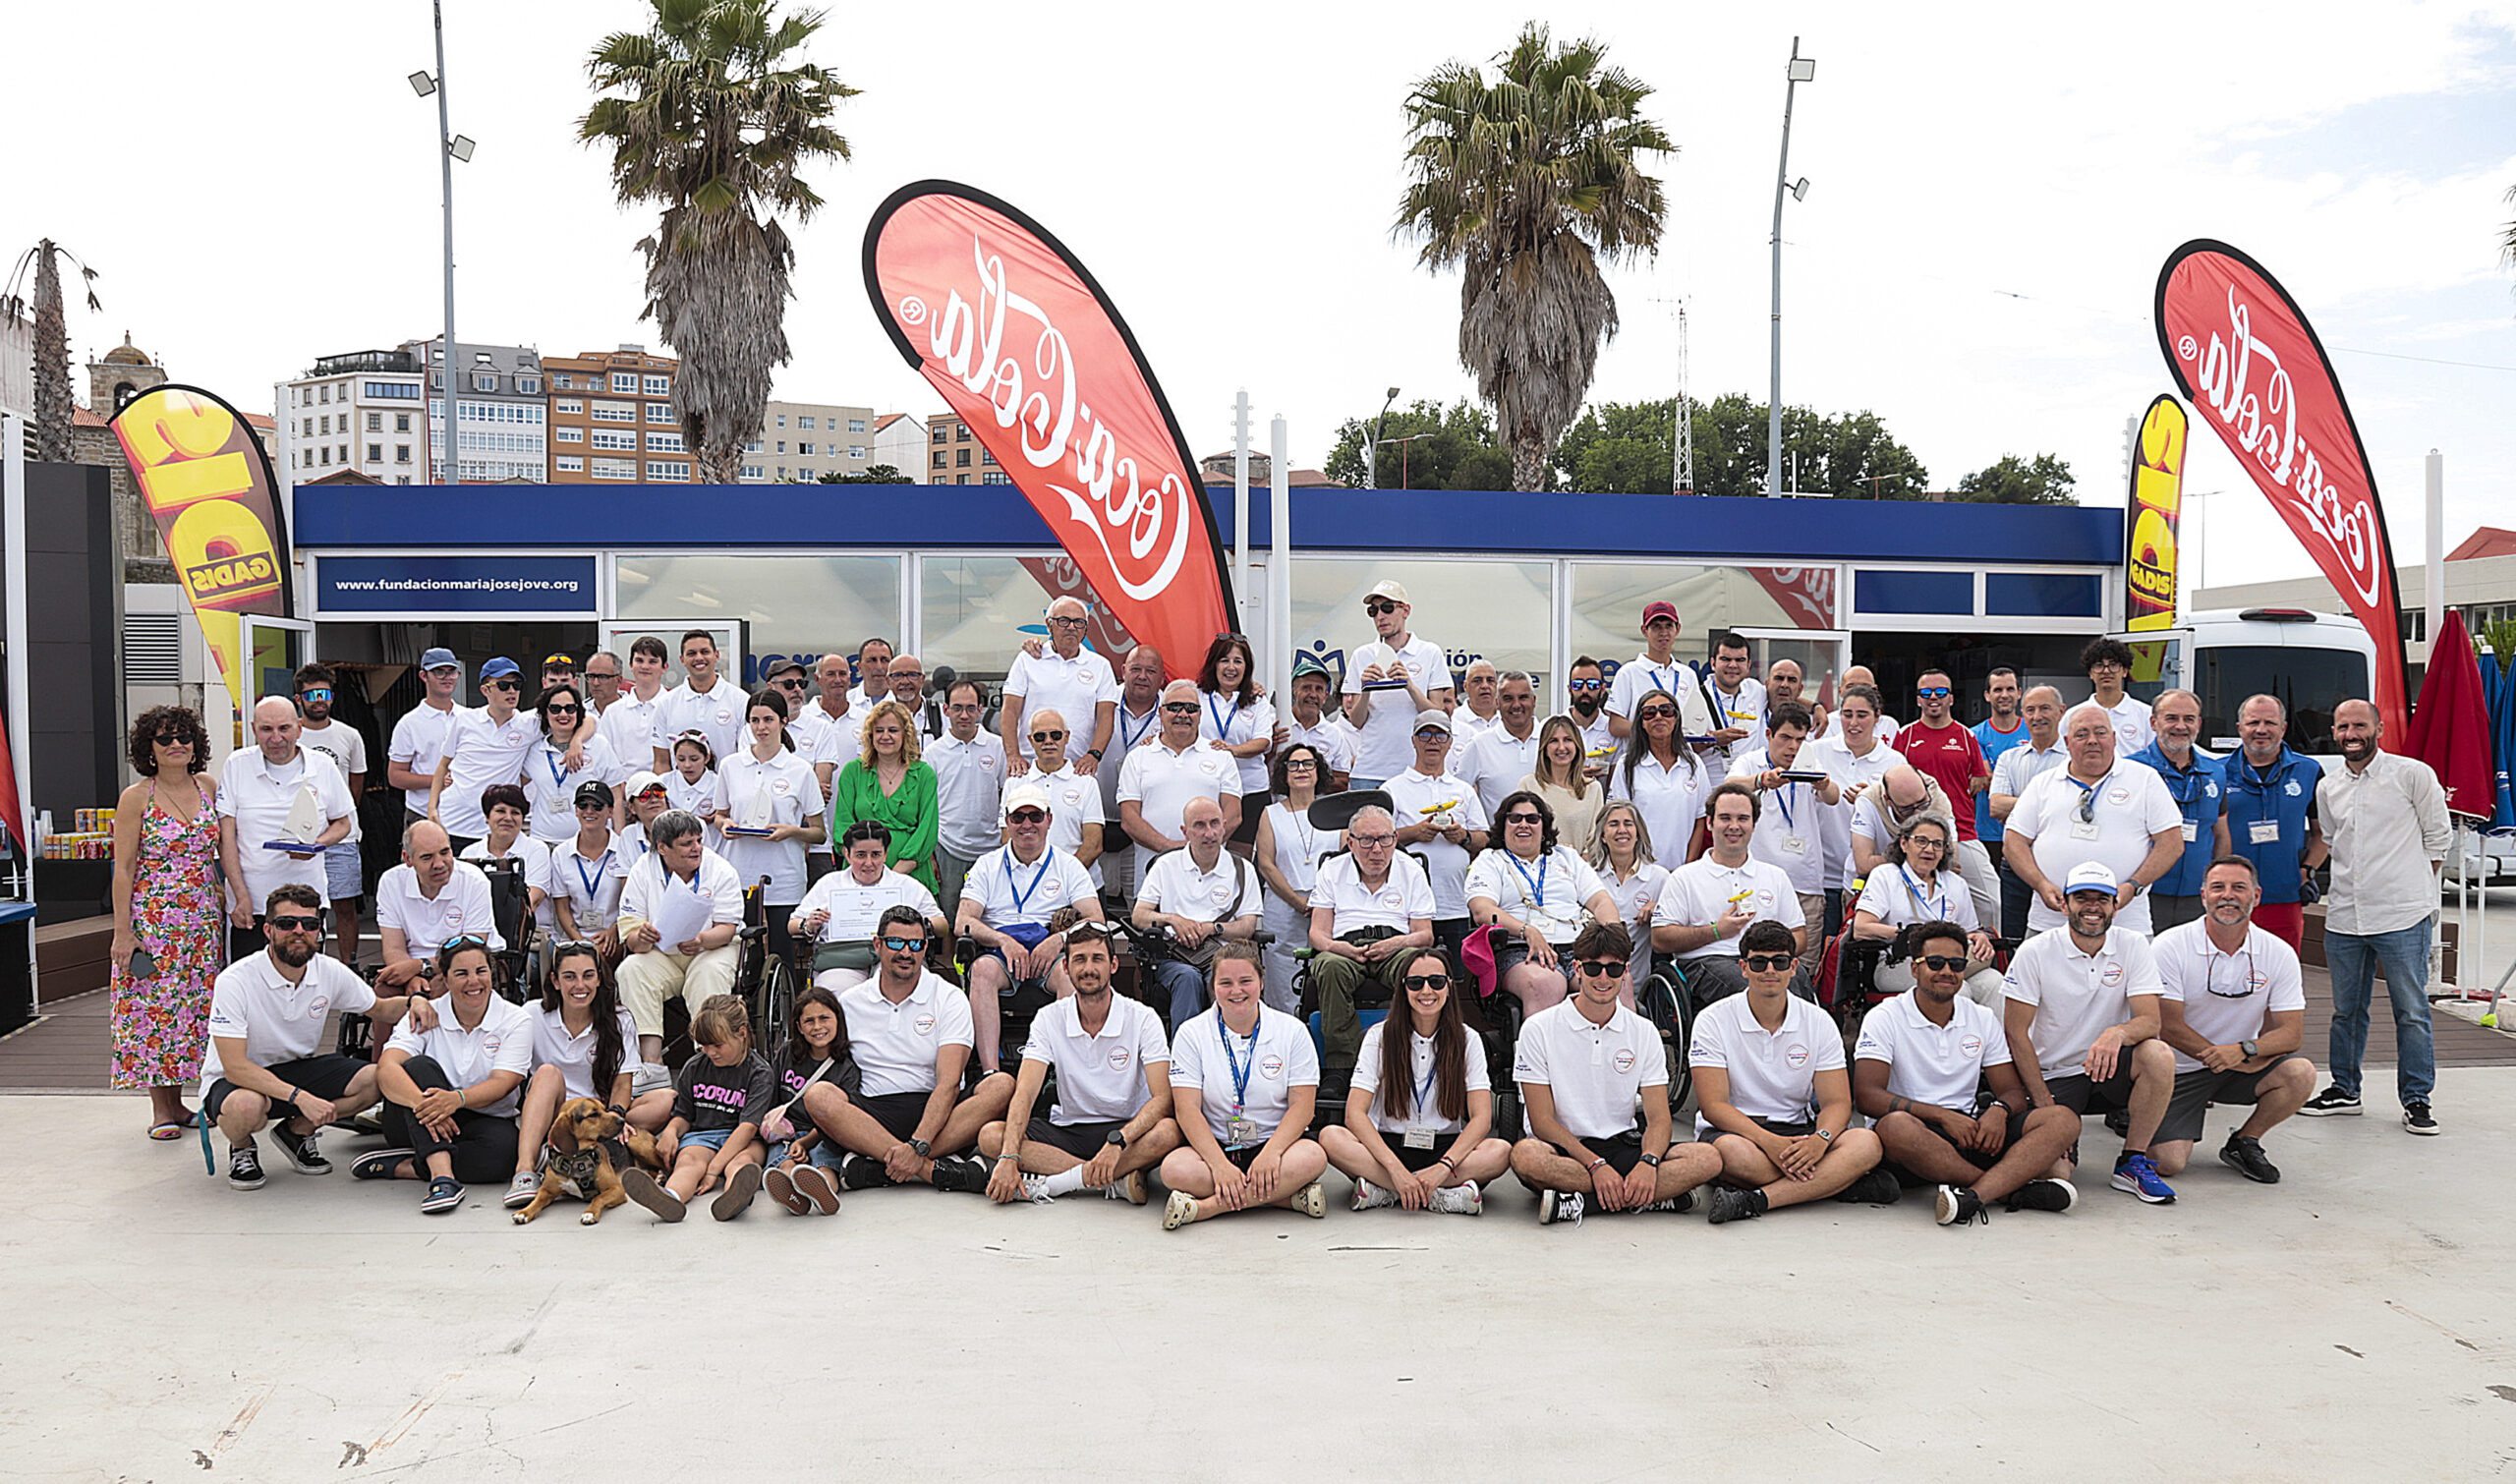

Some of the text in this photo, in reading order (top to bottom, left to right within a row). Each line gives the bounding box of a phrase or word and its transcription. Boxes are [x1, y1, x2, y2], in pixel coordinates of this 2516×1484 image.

[335, 578, 579, 592] www.fundacionmariajosejove.org
[2131, 563, 2171, 596] GADIS
[584, 782, 598, 791] M
